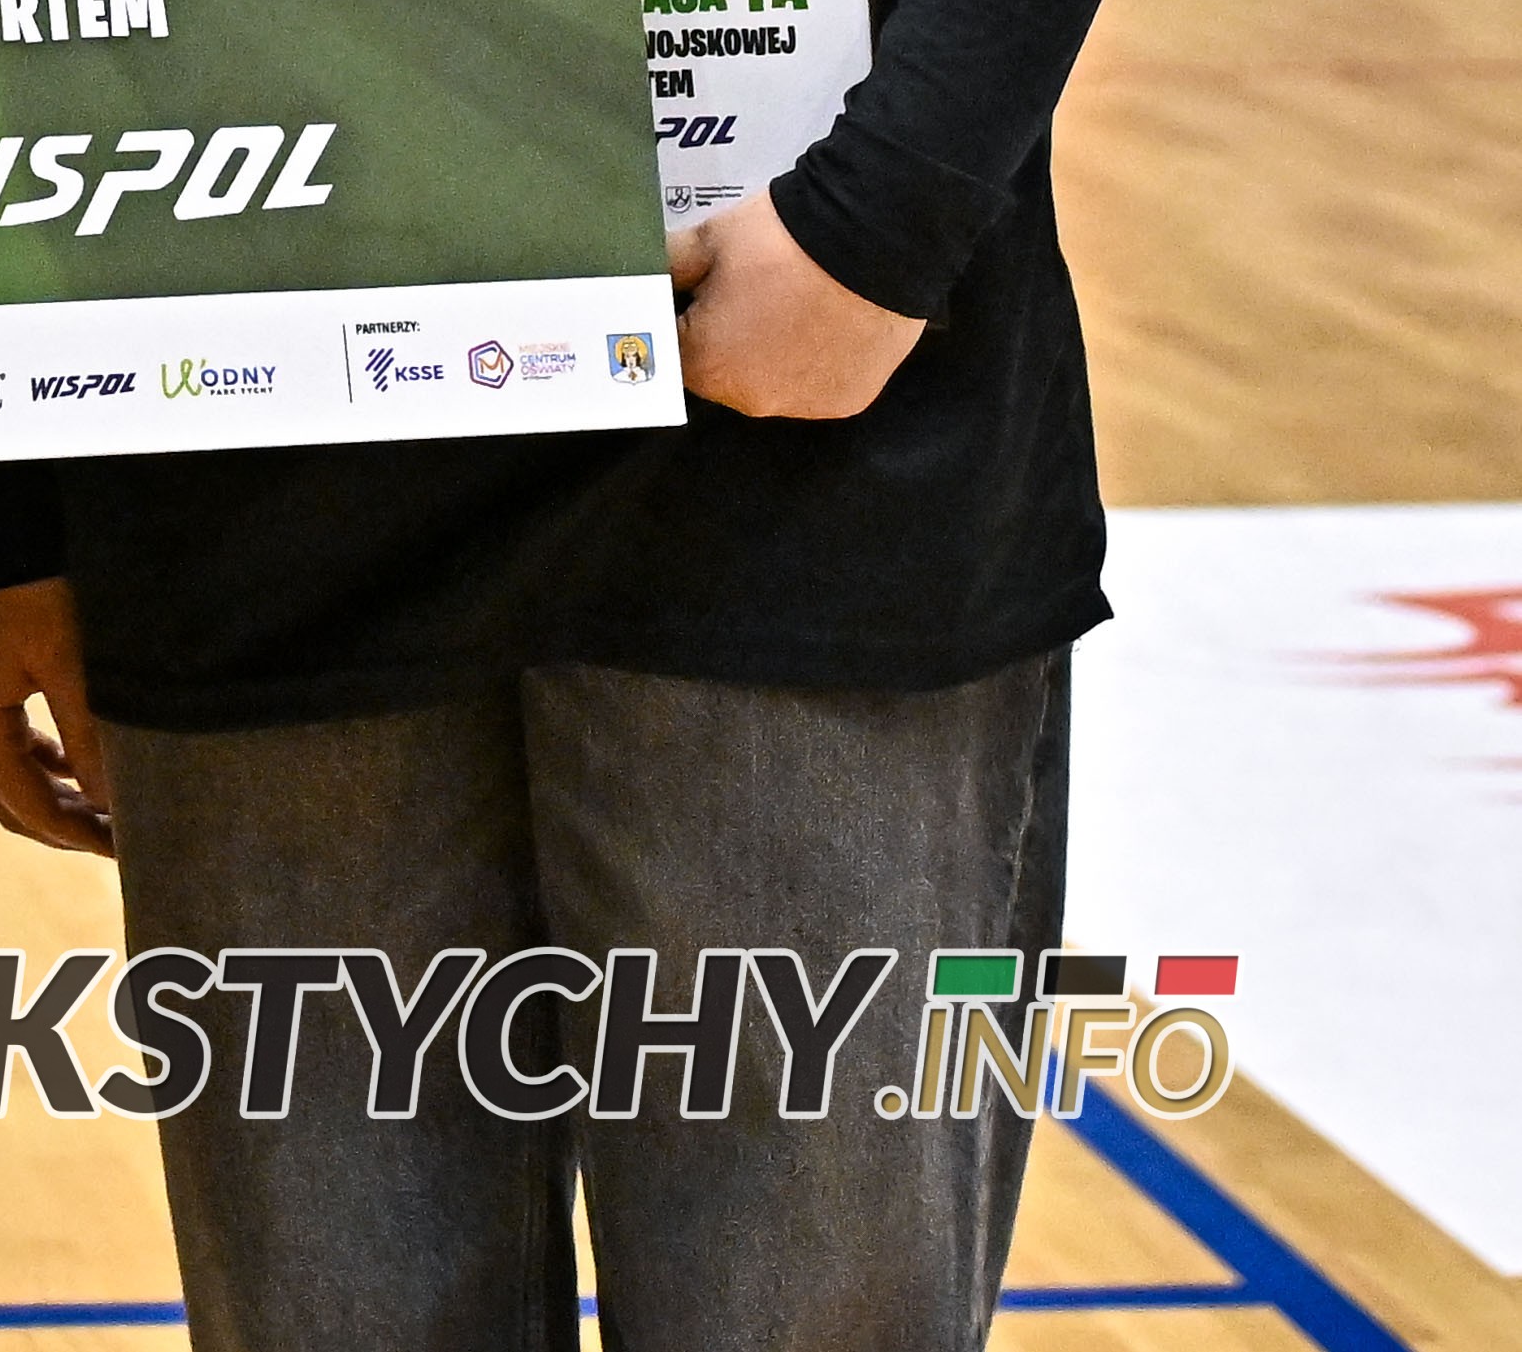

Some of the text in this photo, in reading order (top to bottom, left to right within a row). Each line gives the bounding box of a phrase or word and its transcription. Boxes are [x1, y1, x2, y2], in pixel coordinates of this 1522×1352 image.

[355, 321, 421, 335] PARTNERZY:
[520, 353, 577, 365] CENTRUM
[395, 365, 445, 382] KSSE
[30, 372, 137, 402] WISPOL
[241, 386, 274, 395] TYCHY
